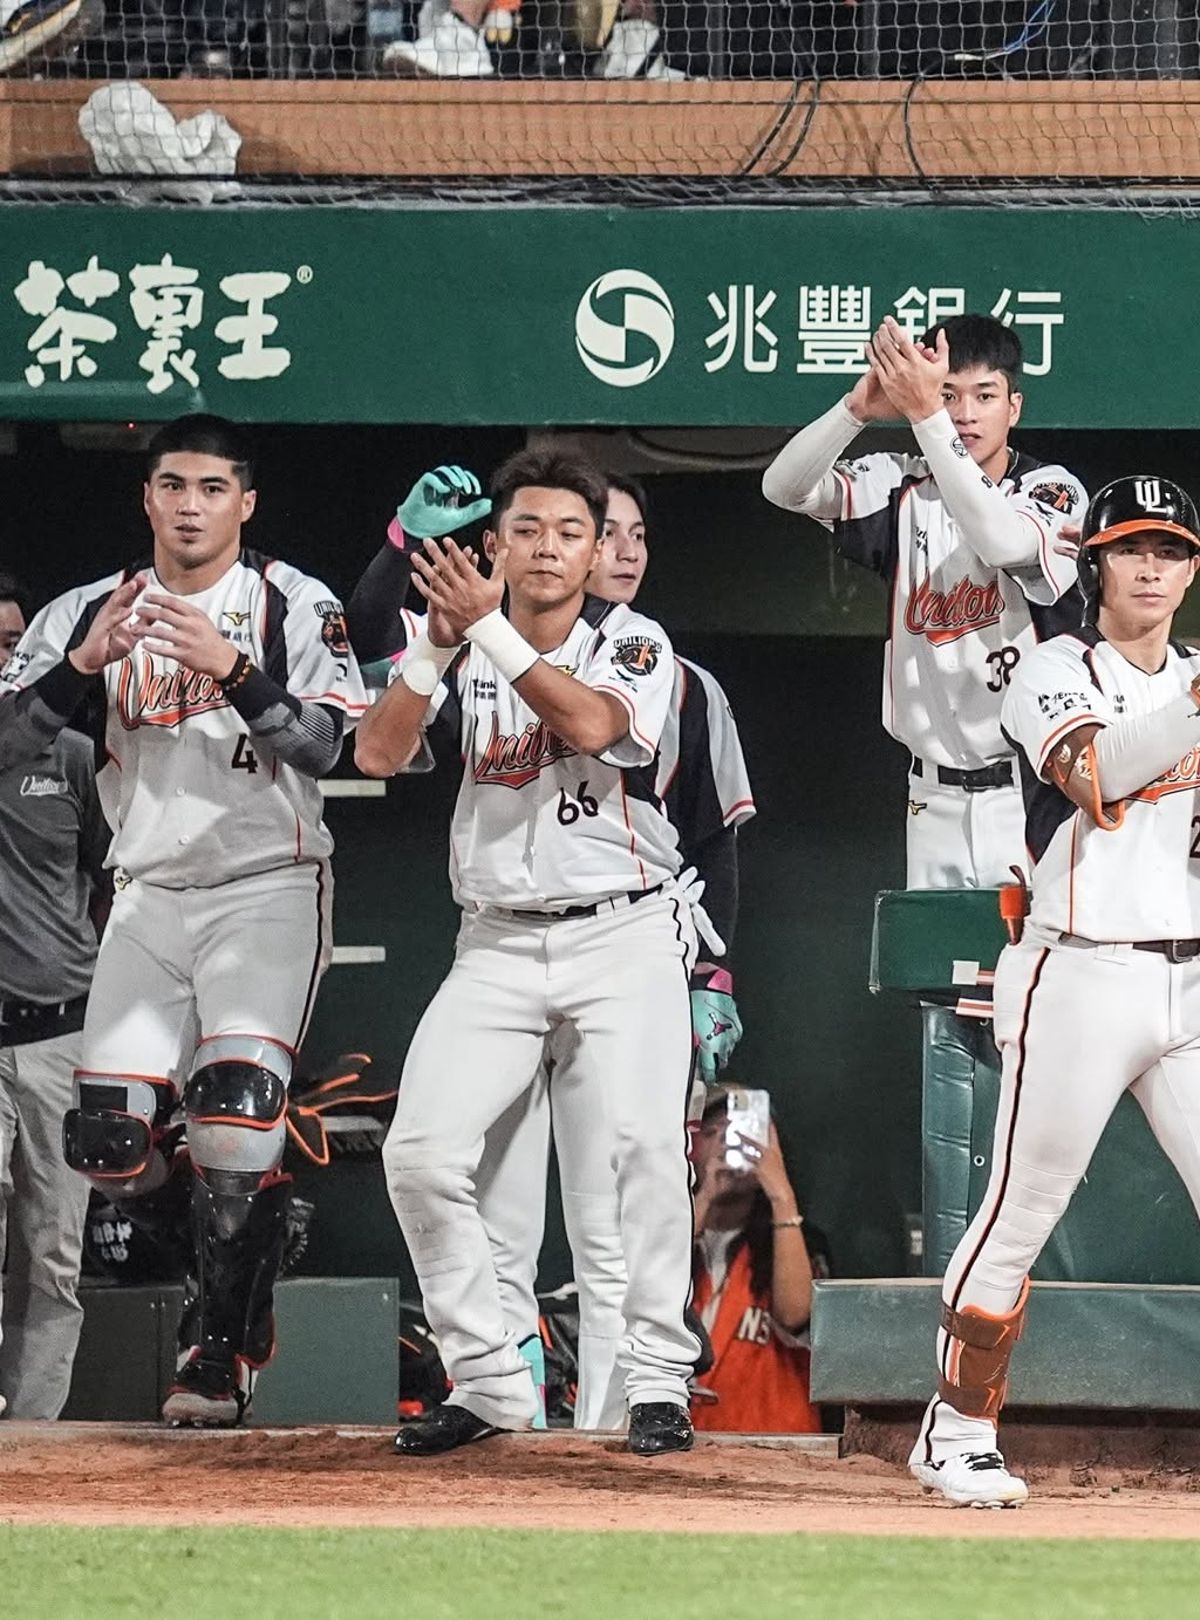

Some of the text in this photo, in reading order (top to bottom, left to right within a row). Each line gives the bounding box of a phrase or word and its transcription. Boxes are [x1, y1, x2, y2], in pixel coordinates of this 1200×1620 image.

[14, 253, 292, 395] 茶裏王
[985, 646, 1021, 692] 38
[231, 733, 258, 774] 4
[557, 780, 599, 826] 66
